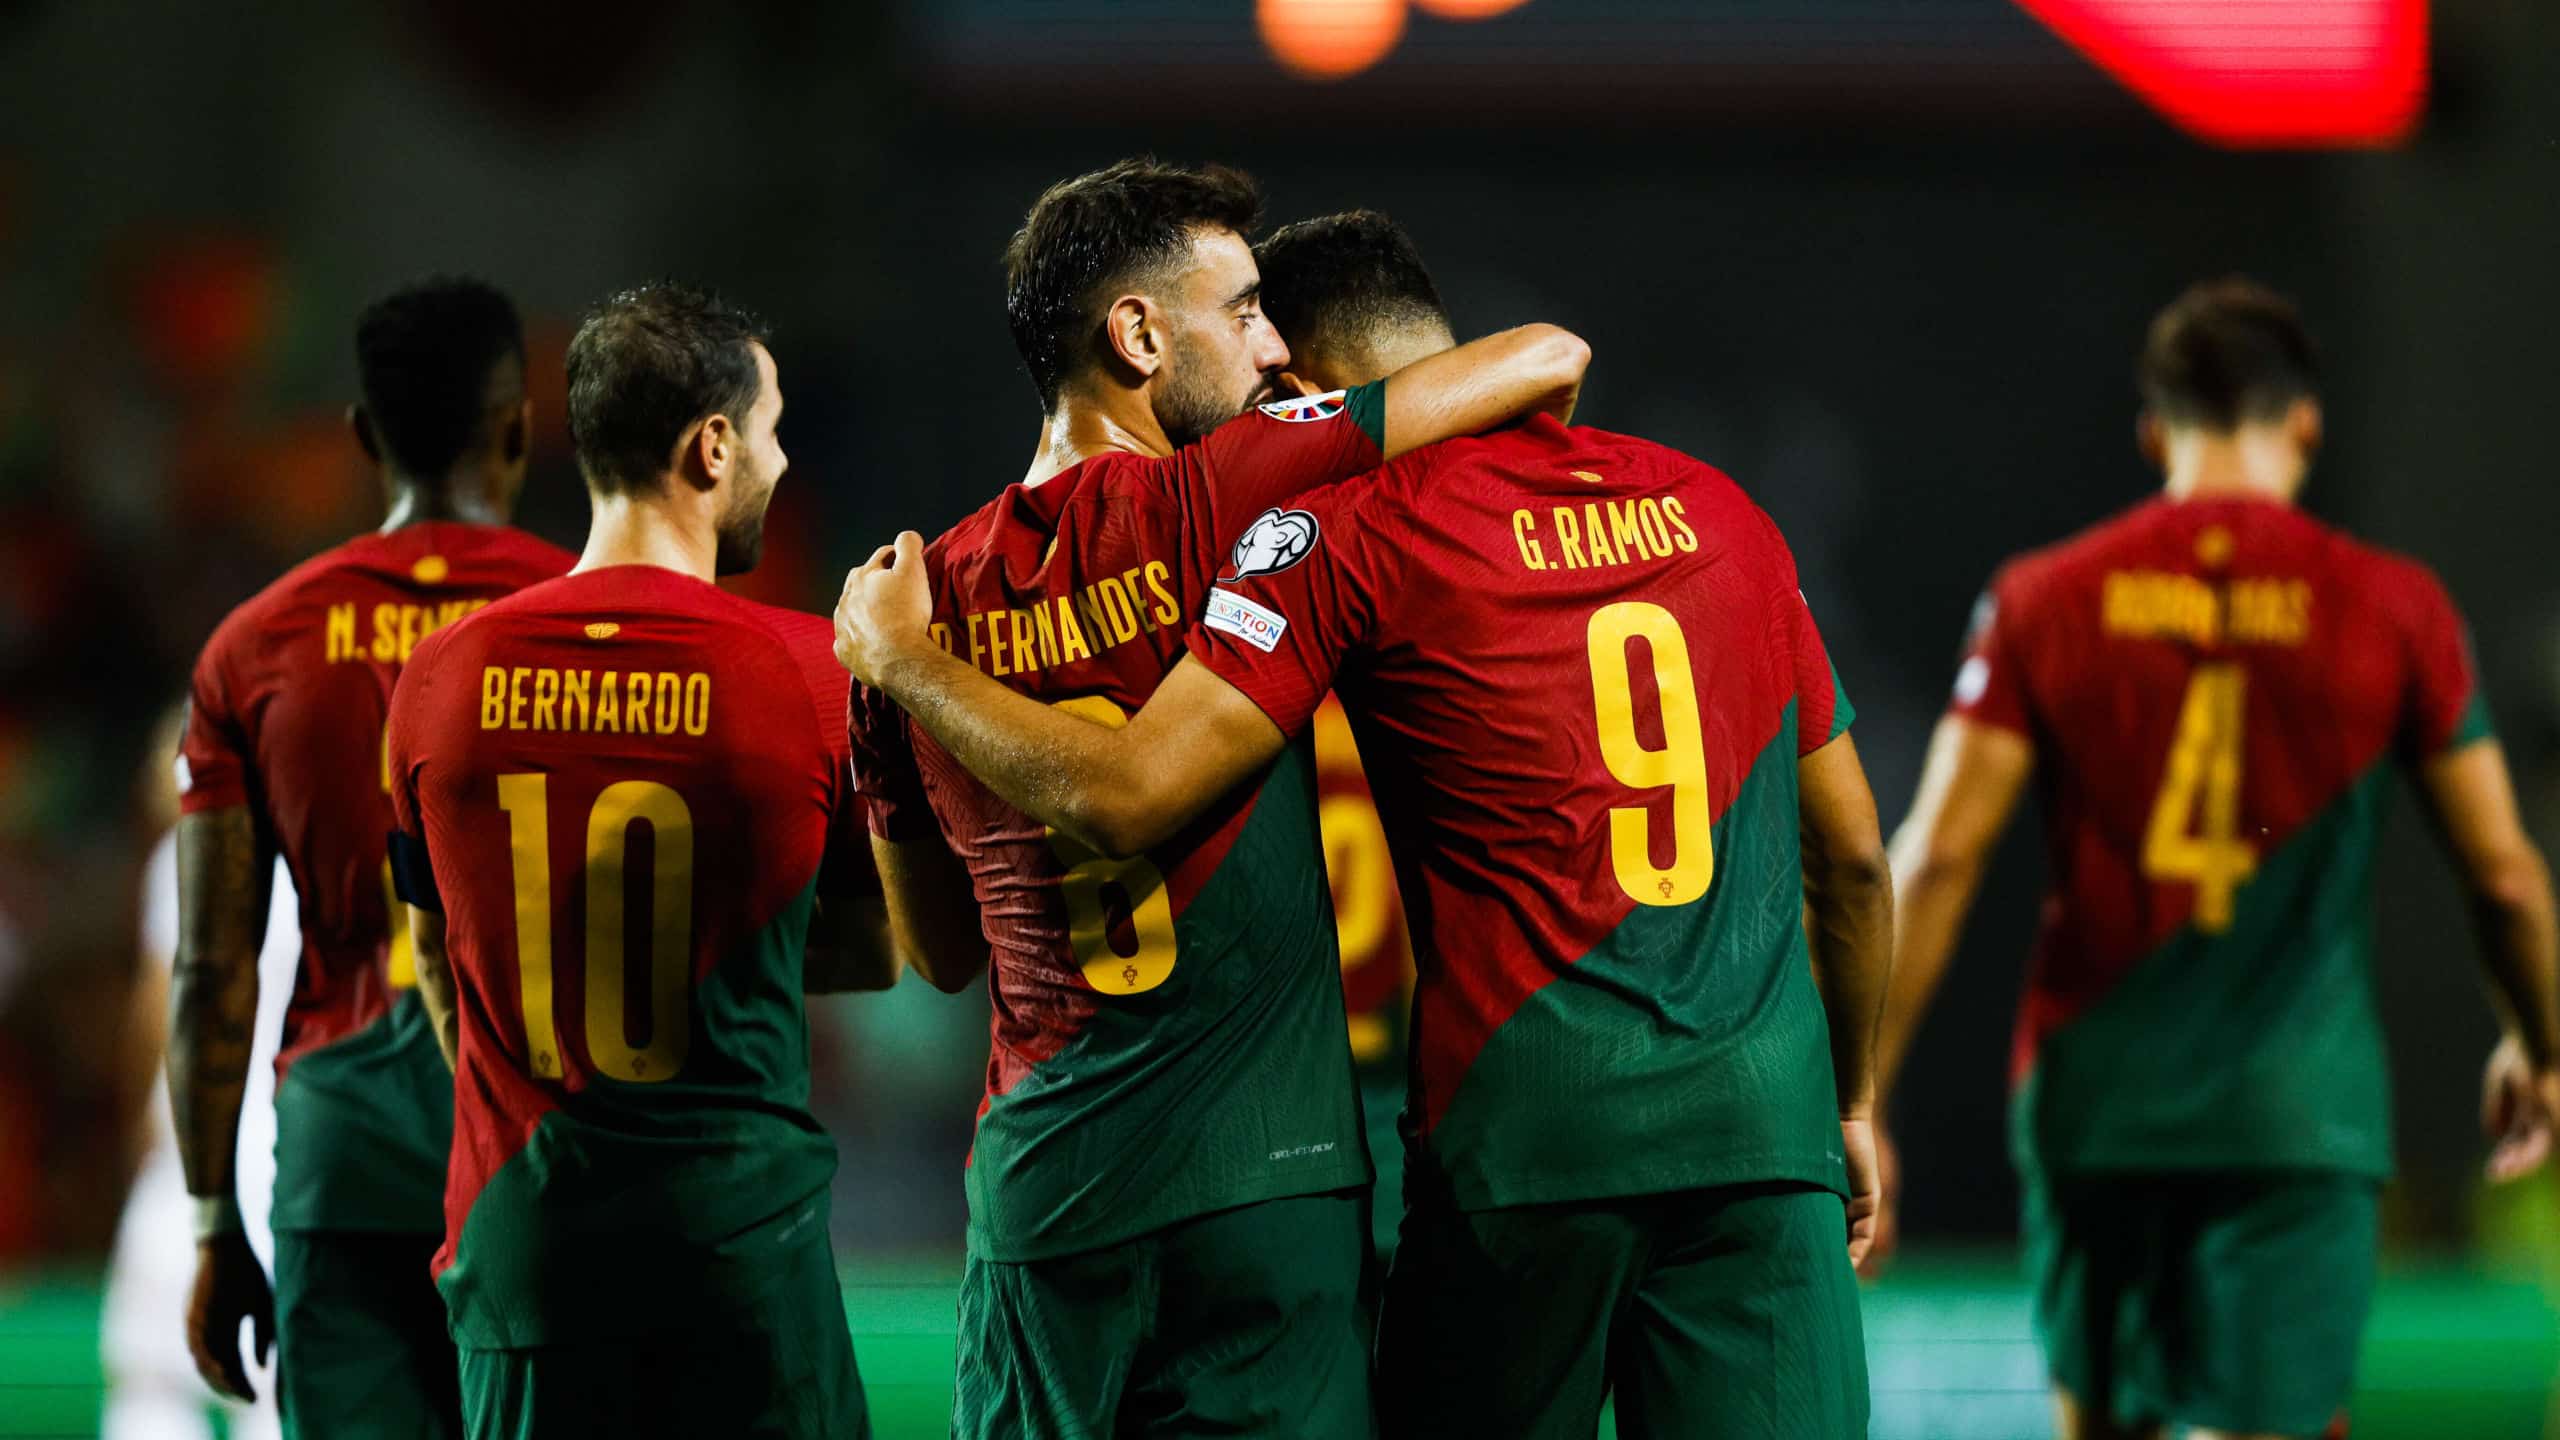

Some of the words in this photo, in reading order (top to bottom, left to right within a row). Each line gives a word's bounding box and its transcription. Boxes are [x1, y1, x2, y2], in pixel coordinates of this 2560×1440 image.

[1513, 496, 1698, 570] G.RAMOS
[481, 666, 711, 736] BERNARDO
[1587, 601, 1714, 906] 9
[2141, 664, 2258, 933] 4
[497, 772, 694, 1083] 10
